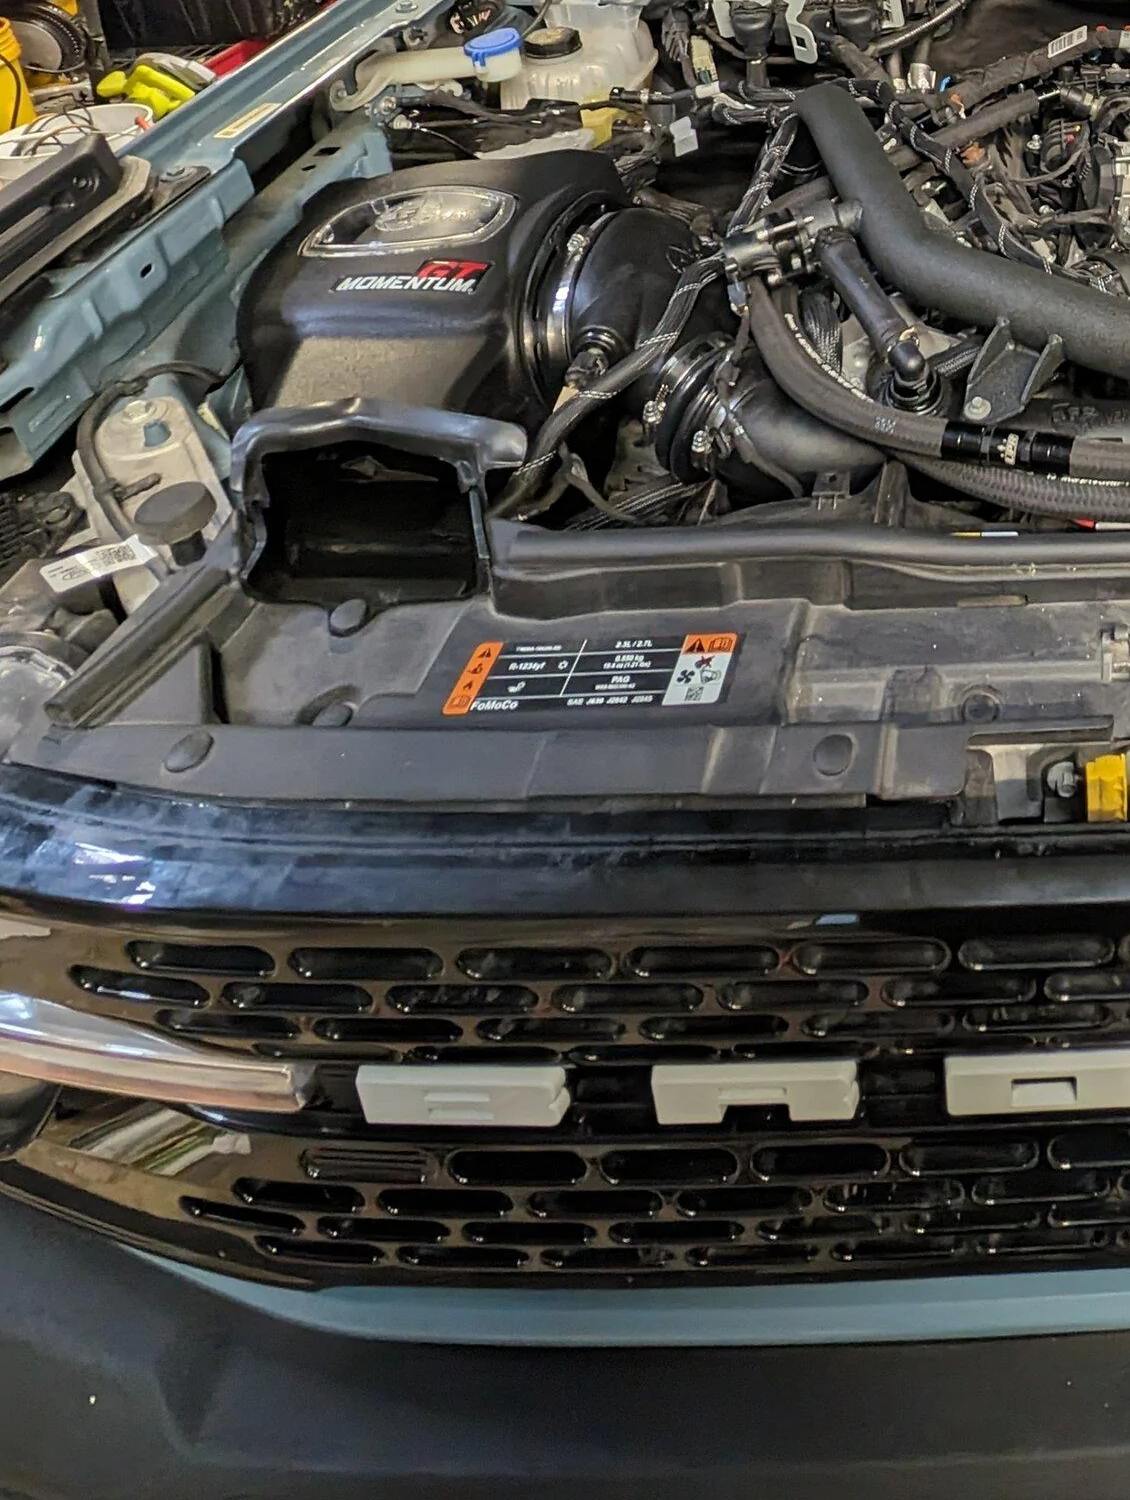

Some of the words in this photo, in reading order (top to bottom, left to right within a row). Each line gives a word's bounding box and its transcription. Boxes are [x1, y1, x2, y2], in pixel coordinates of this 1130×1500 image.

[418, 260, 489, 279] GT
[336, 277, 474, 293] MOMENTUM
[508, 661, 546, 671] R-1234yf
[611, 675, 631, 683] PAG
[470, 700, 518, 711] FoMoCo
